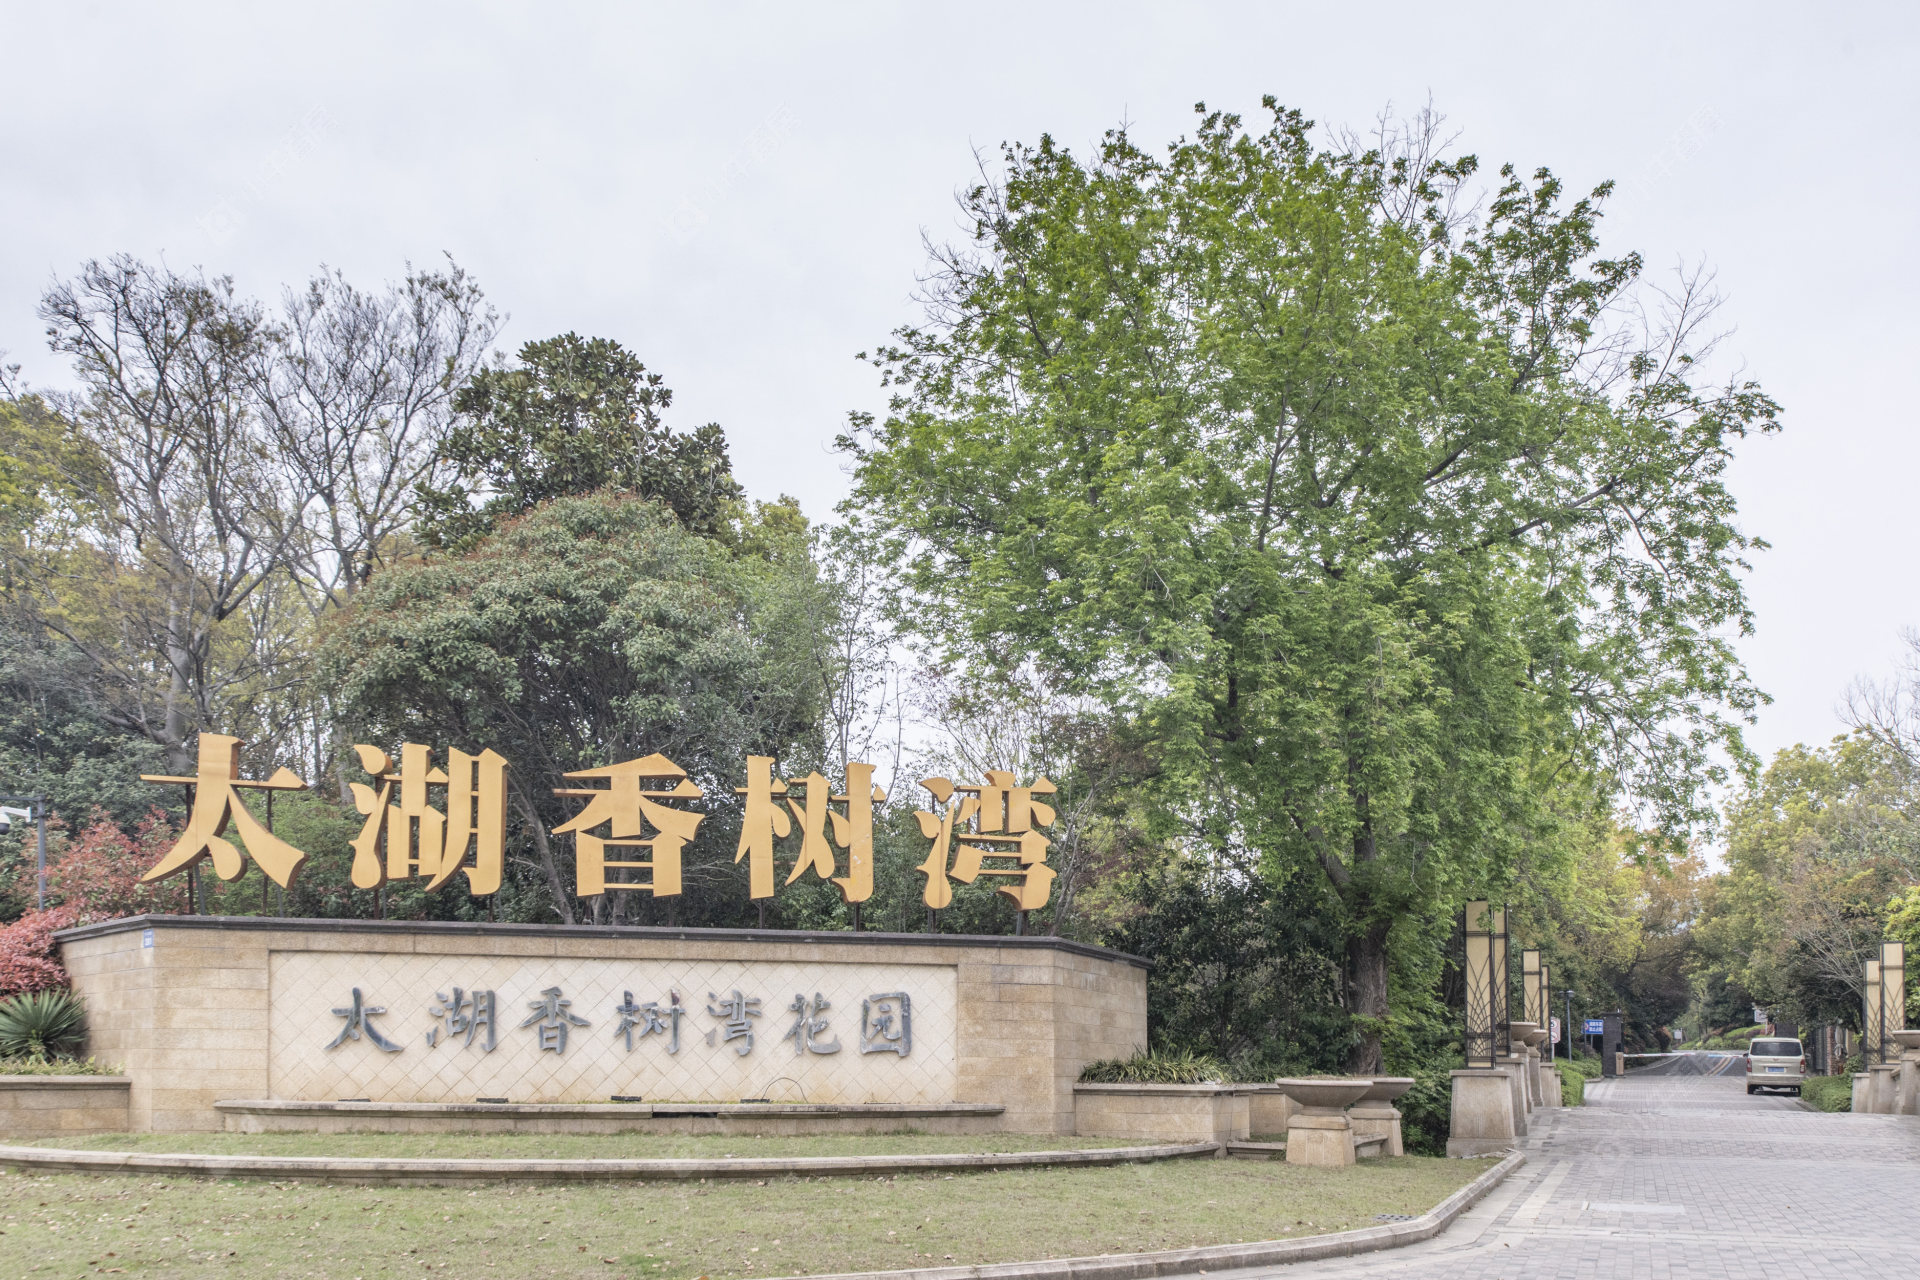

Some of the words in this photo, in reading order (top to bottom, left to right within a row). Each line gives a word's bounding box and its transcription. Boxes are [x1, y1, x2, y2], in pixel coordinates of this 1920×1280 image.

[141, 732, 1058, 910] 太湖香树湾
[325, 986, 912, 1058] 太湖香树湾花园
